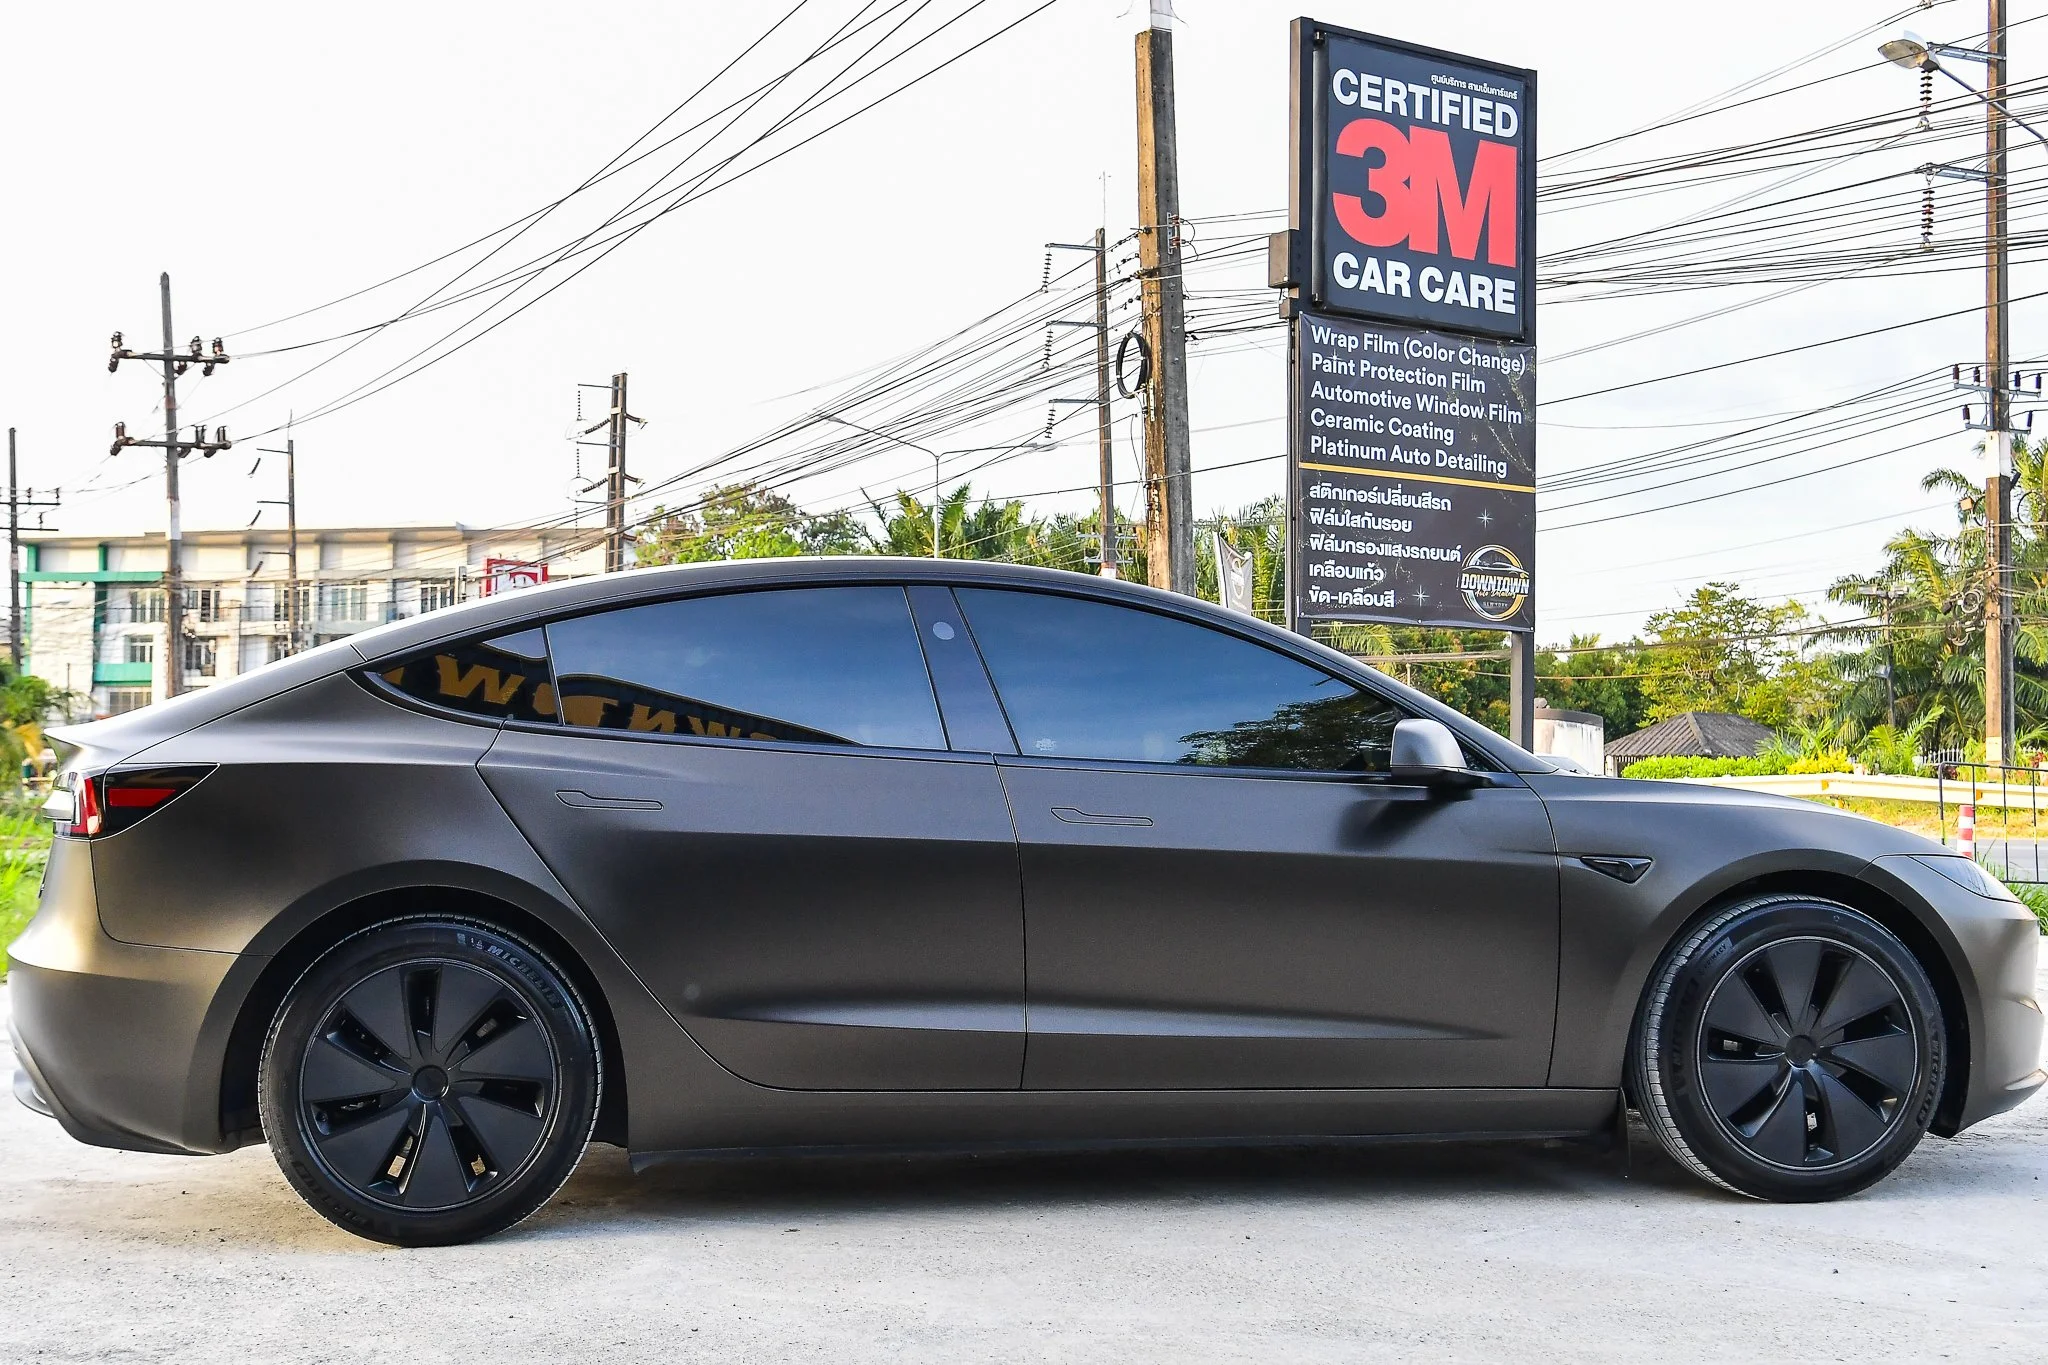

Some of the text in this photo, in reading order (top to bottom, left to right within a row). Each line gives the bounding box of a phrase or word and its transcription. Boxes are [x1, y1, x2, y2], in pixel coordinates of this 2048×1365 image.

[1332, 68, 1518, 138] CERTIFIED
[1332, 118, 1518, 268] 3M
[1332, 252, 1516, 315] CAR CARE
[1311, 325, 1526, 377] Wrap Film (Color Change)
[1312, 353, 1486, 394] Paint Protection Film
[1310, 380, 1522, 424] Automotive Window Film
[1310, 408, 1455, 446] Ceramic Coating
[1310, 435, 1507, 479] Platinum Auto Detailing
[1309, 507, 1413, 533] ฟิล์มใสกันรอย
[1309, 559, 1385, 581] เคลือบแก้ว
[1461, 572, 1530, 594] DOWNTOWN
[1309, 584, 1395, 608] ขัด-เคลือบสี
